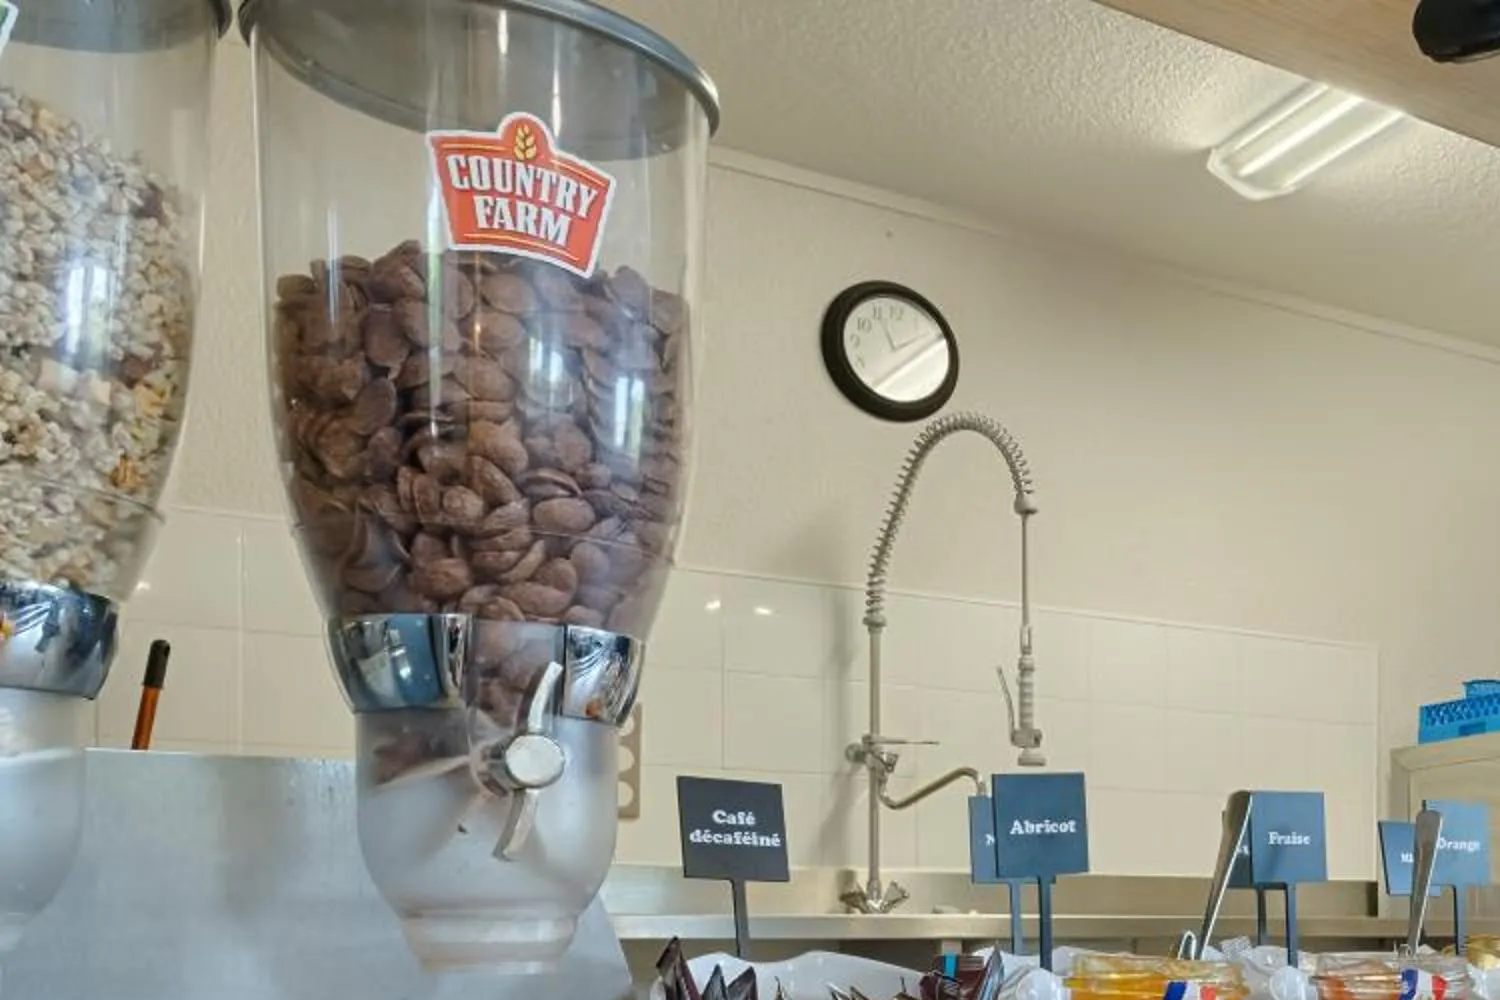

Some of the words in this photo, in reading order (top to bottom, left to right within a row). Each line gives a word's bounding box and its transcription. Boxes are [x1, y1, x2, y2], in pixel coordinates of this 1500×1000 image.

[447, 155, 598, 218] COUNTRY
[473, 195, 572, 246] FARM
[712, 809, 756, 826] Café
[1009, 819, 1077, 835] Abricot
[689, 829, 781, 847] décaféiné
[1267, 831, 1311, 845] Fraise
